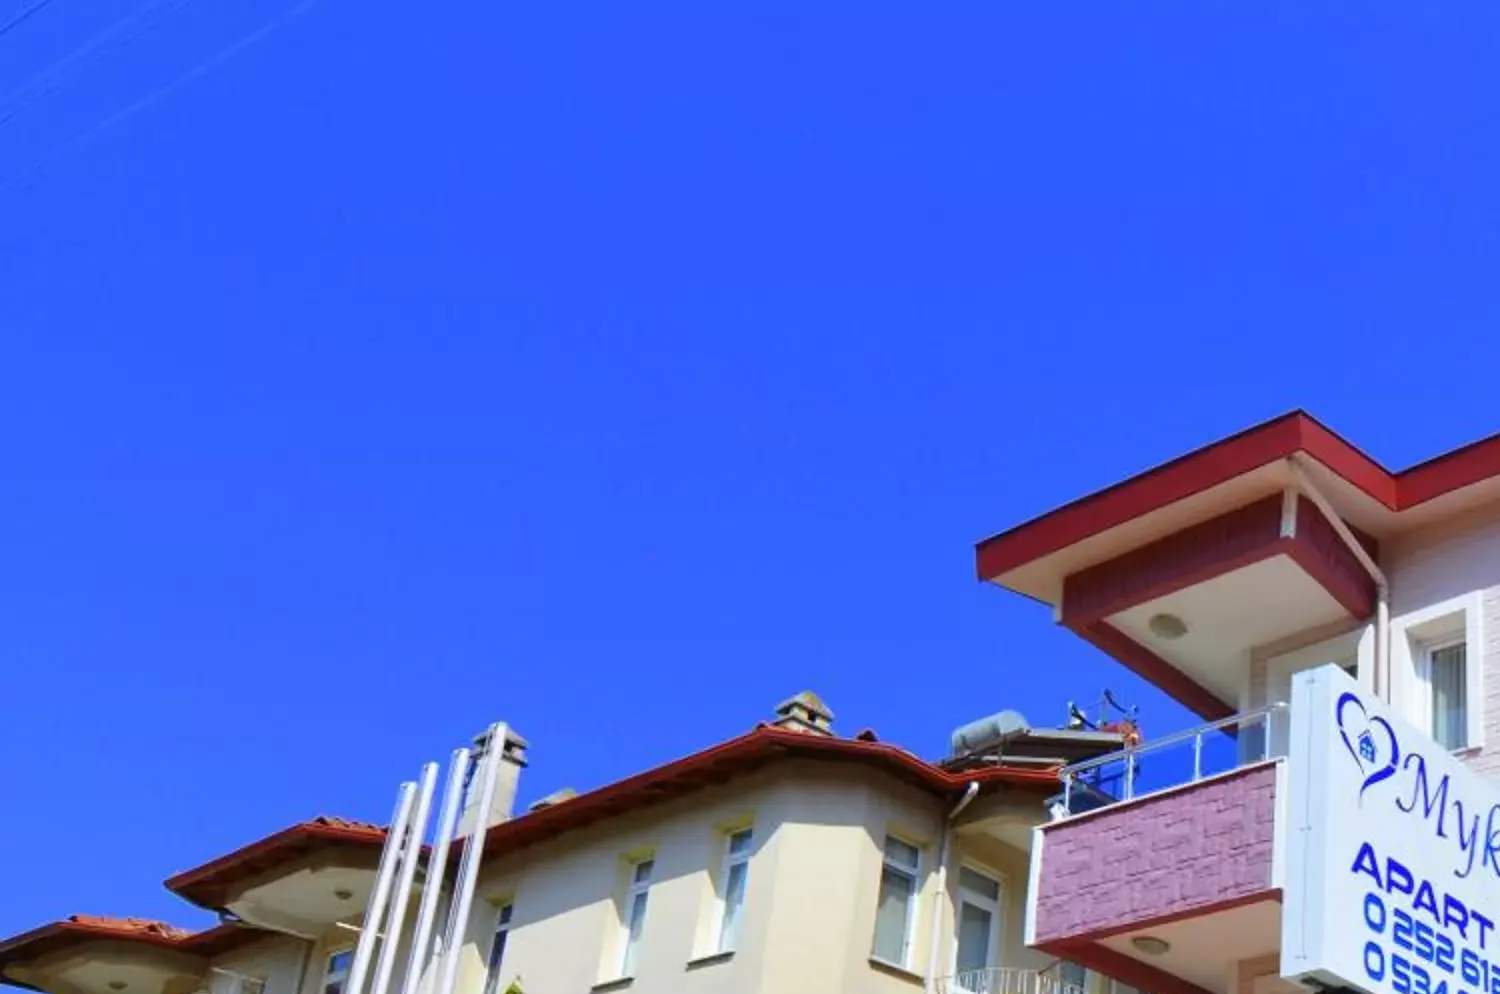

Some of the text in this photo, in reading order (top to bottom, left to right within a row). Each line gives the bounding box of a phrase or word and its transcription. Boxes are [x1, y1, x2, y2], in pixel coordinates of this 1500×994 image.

[1351, 841, 1495, 950] APART
[1363, 891, 1387, 935] 0
[1392, 907, 1455, 974] 252
[1363, 940, 1386, 983] 0
